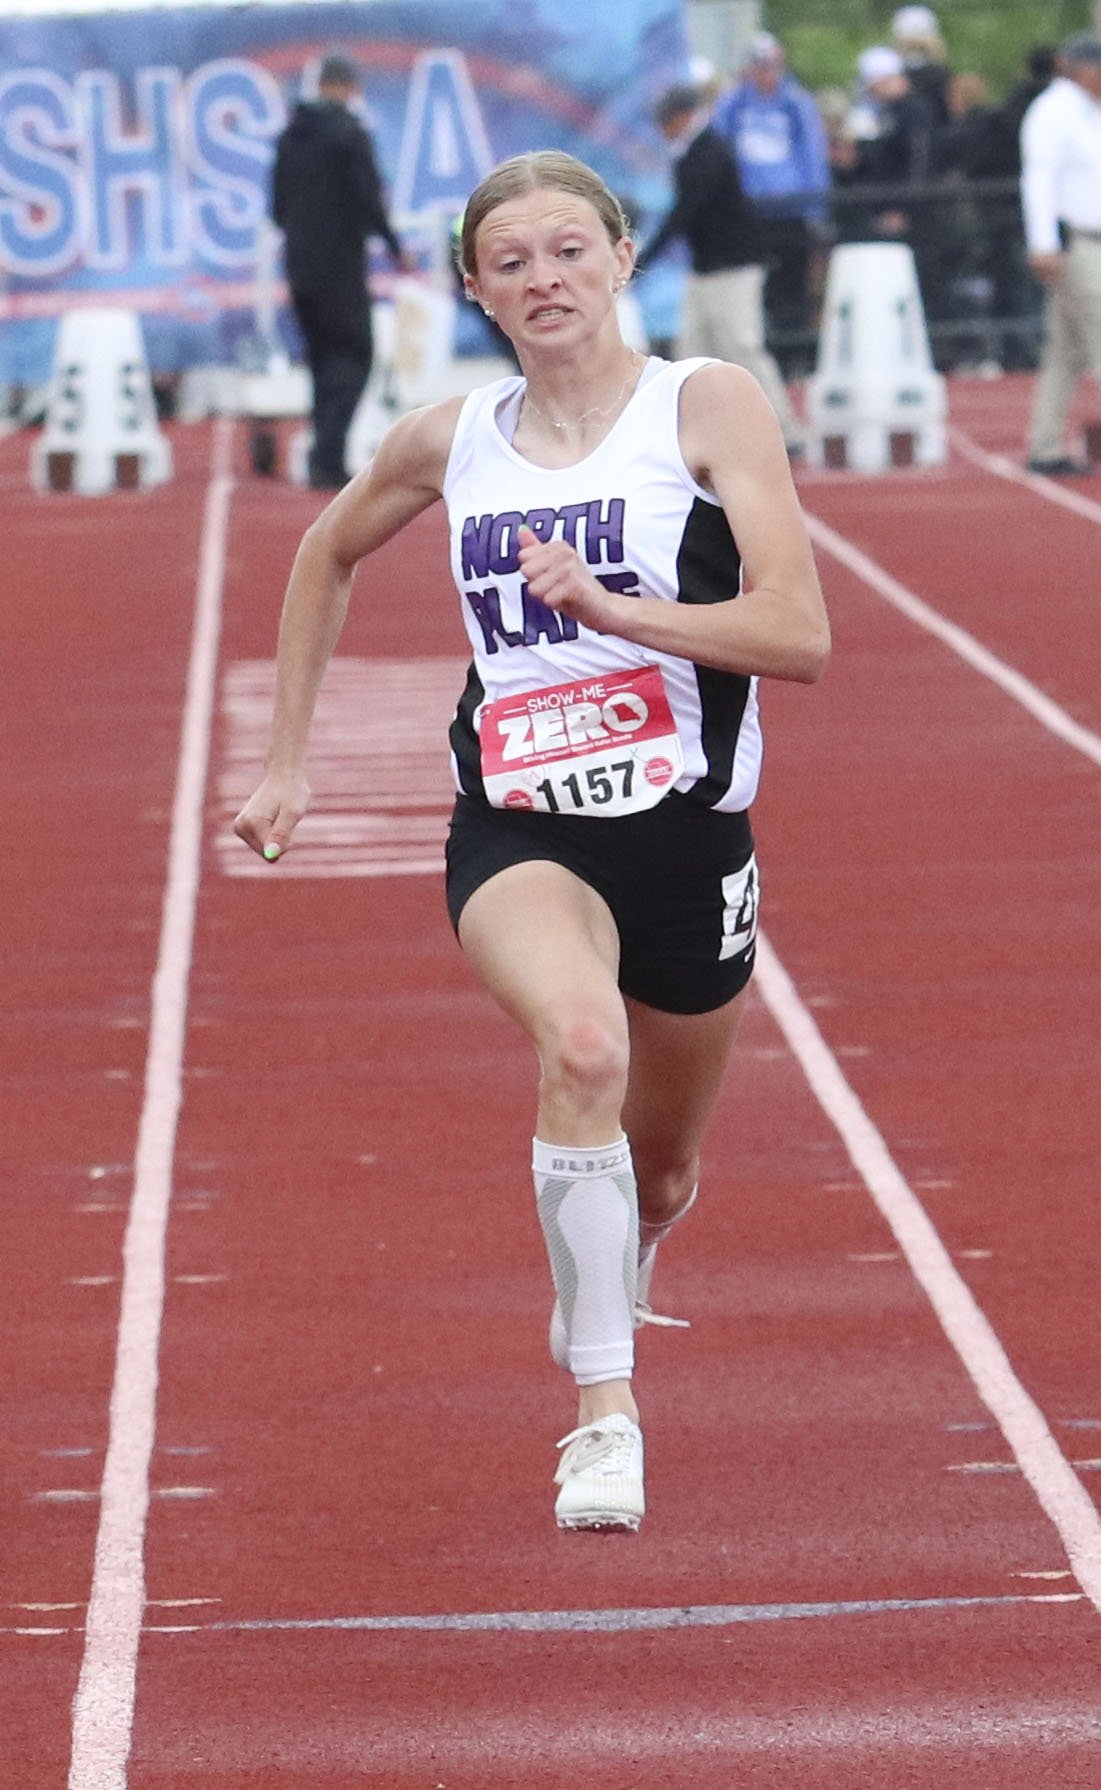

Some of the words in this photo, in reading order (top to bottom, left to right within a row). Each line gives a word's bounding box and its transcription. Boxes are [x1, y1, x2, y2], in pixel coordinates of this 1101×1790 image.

[462, 498, 625, 581] NORTH
[497, 692, 649, 761] ZERO
[527, 683, 606, 713] SHOW-ME
[536, 760, 635, 813] 1157
[734, 866, 755, 942] 4
